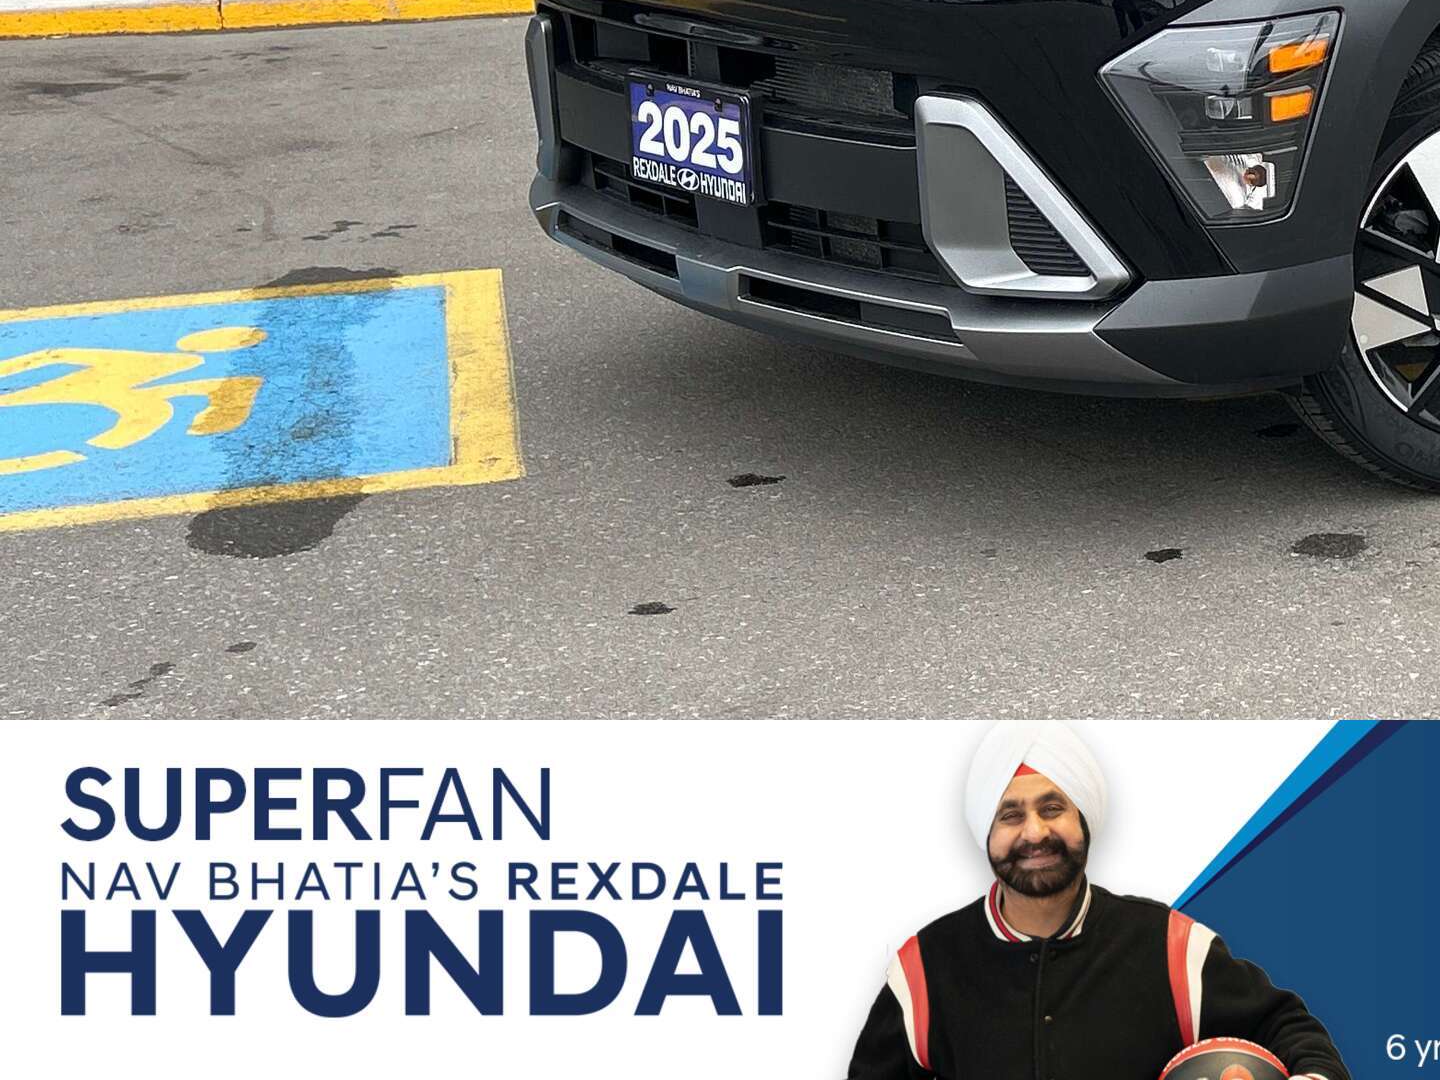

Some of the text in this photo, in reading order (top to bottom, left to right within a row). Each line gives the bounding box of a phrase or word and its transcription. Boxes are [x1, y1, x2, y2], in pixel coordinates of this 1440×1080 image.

[638, 101, 743, 174] 2025
[633, 156, 746, 204] REXDALE HYUNDAI
